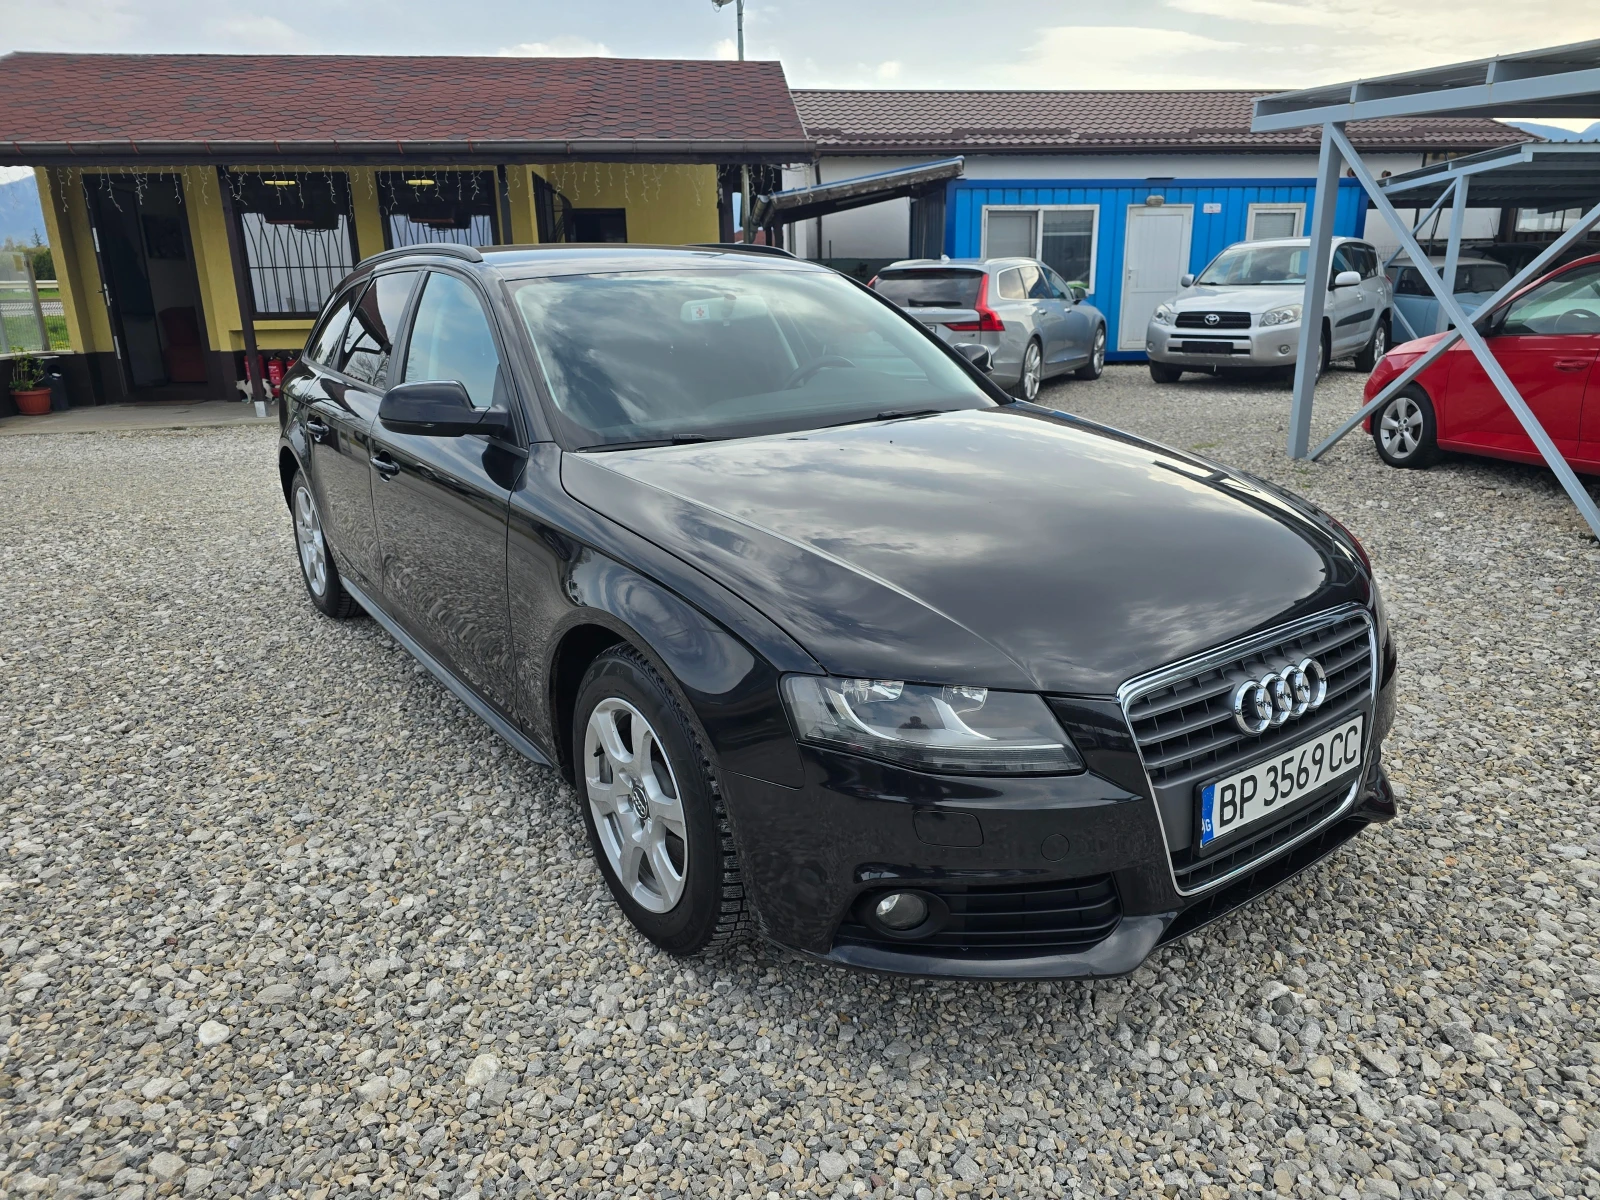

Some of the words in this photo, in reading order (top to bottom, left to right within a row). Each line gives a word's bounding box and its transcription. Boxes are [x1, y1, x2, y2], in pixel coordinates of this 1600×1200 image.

[1220, 774, 1258, 828] BP
[1264, 742, 1325, 807] 3569
[1329, 725, 1358, 773] CC
